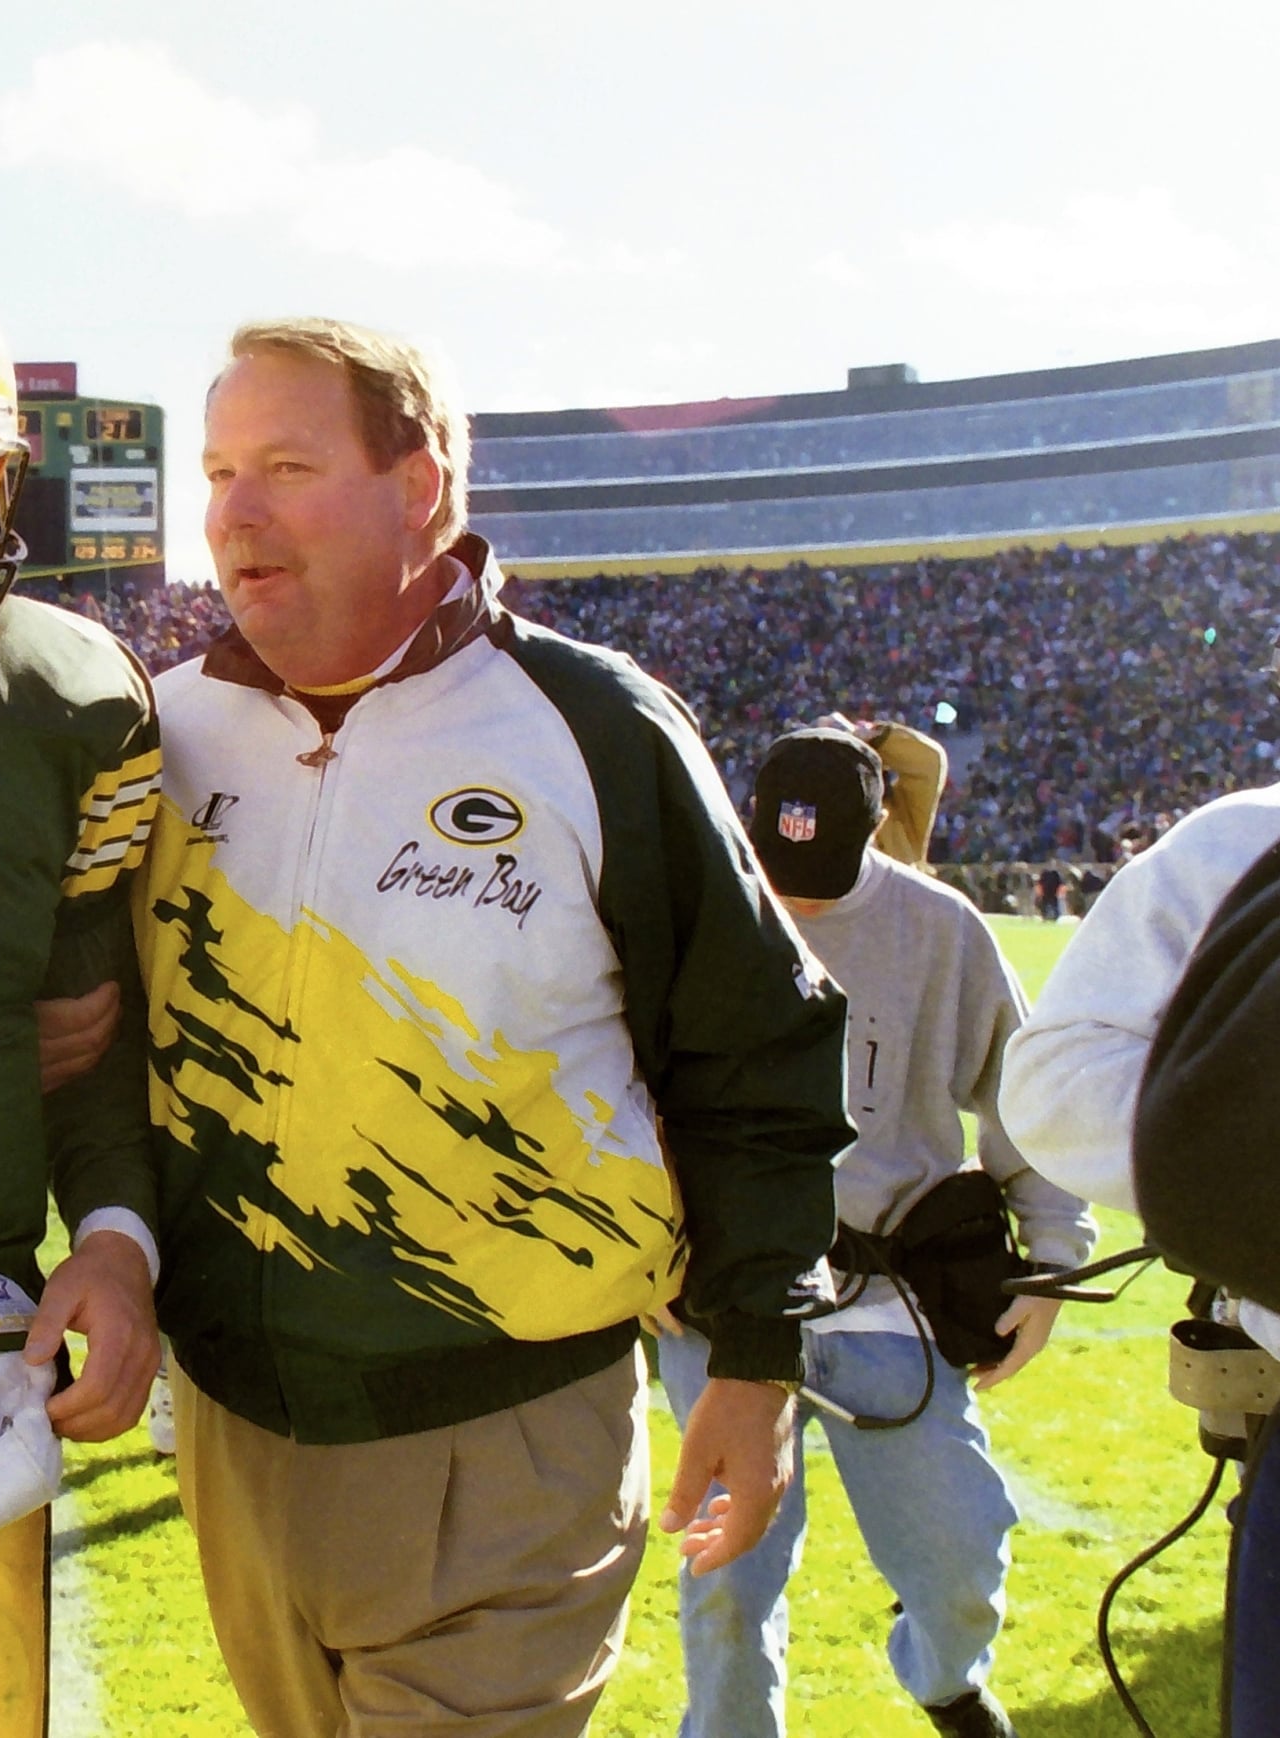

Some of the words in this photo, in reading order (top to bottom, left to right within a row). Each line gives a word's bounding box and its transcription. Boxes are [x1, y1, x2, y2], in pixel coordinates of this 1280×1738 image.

[431, 788, 523, 845] G
[781, 815, 814, 839] NFL
[376, 841, 475, 899] Green
[473, 853, 542, 930] Bay
